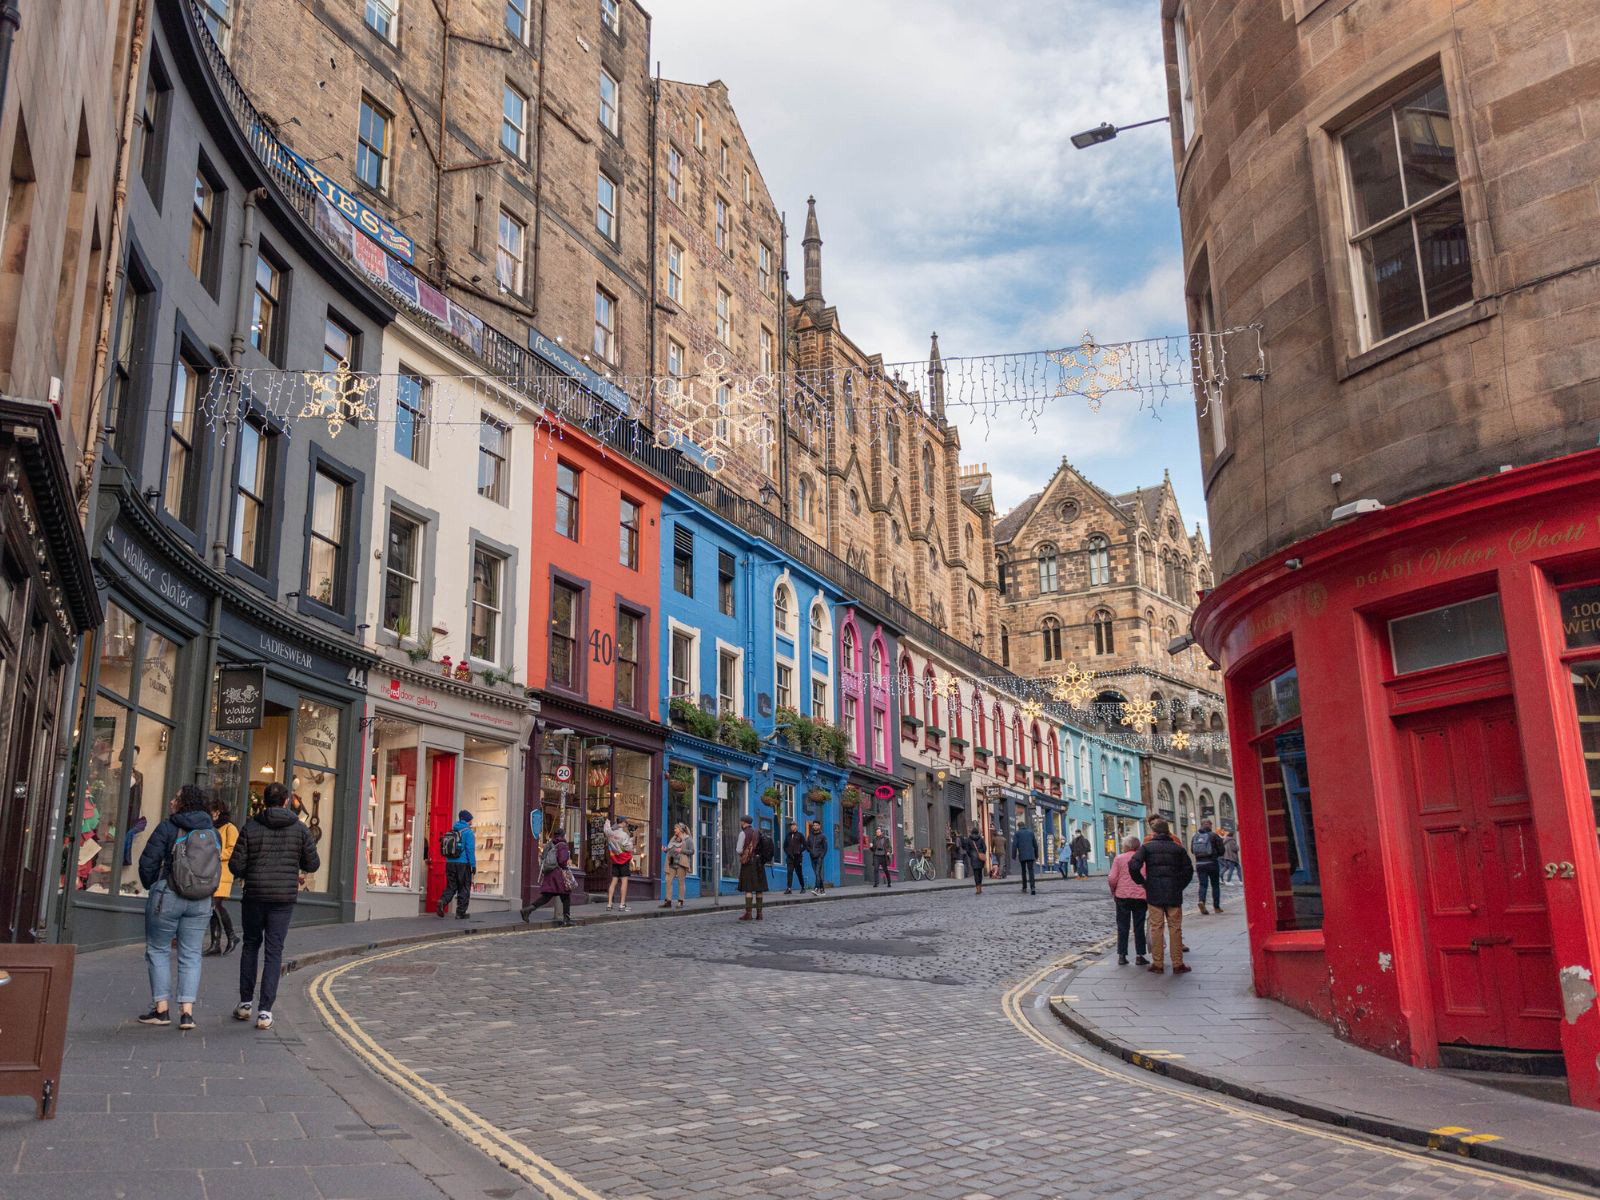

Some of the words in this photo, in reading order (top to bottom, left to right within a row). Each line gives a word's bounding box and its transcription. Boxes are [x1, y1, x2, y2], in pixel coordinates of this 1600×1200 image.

[123, 538, 155, 582] Walker
[160, 571, 193, 609] Slater
[259, 634, 313, 669] LADIESWEAR
[589, 629, 612, 666] 40
[225, 705, 257, 715] walker
[416, 694, 438, 710] gallery
[226, 715, 255, 725] slater
[558, 769, 570, 777] 20
